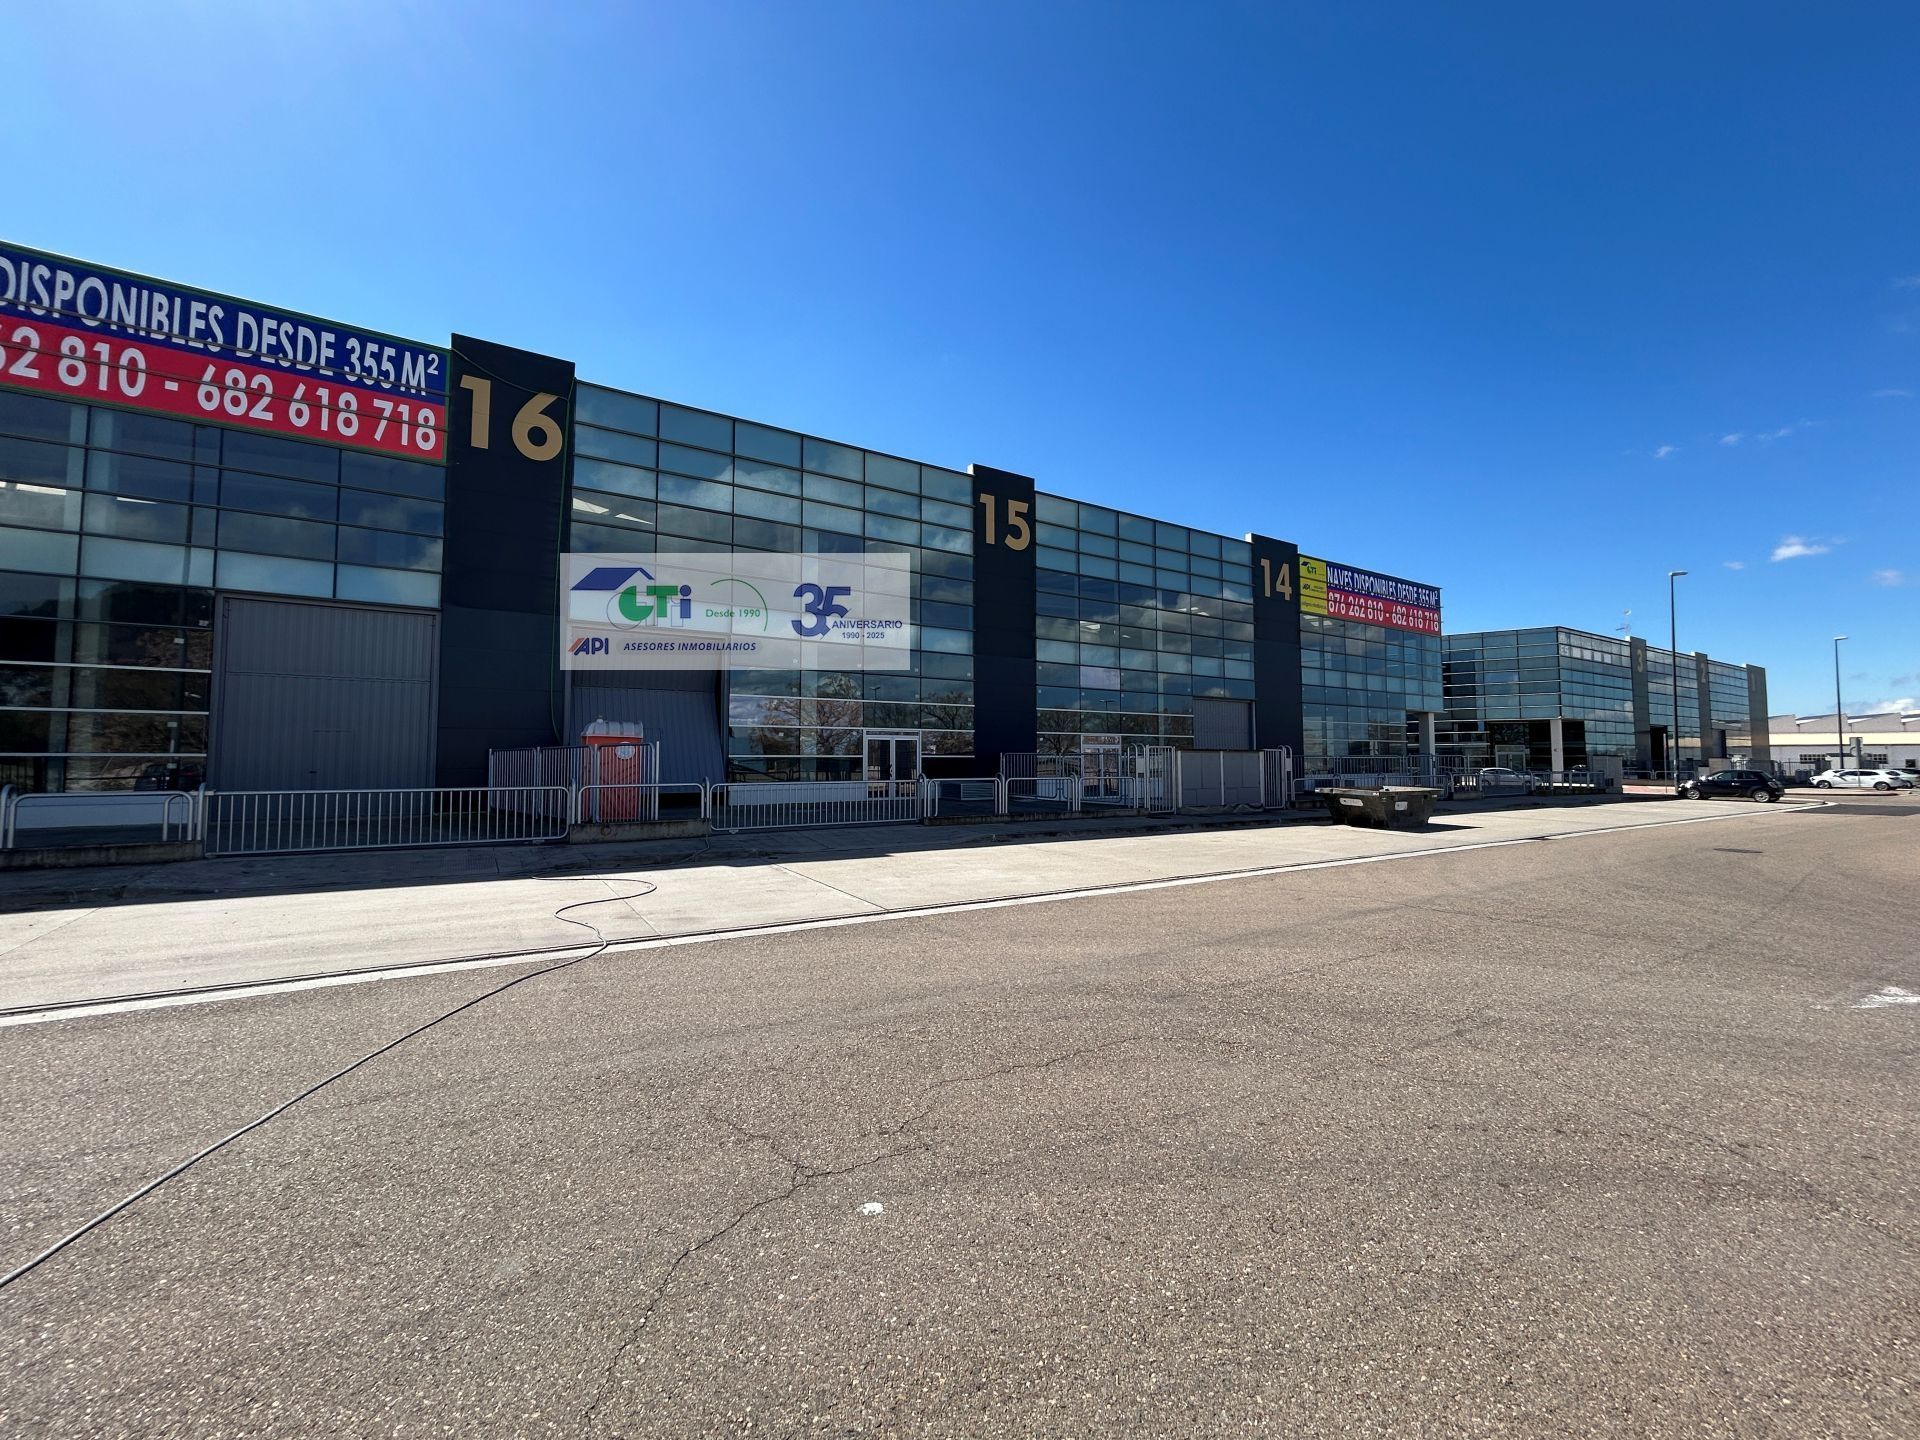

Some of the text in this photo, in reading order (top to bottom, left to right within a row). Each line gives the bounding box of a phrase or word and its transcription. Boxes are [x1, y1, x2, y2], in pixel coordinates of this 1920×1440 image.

[0, 257, 224, 352] DISPONIBLES
[236, 312, 336, 376] DESDE
[344, 338, 395, 388] 355
[0, 325, 40, 379] 2
[58, 336, 146, 398] 810
[197, 364, 274, 421] 682
[289, 382, 359, 436] 618
[373, 399, 436, 450] 718
[460, 374, 563, 461] 16
[979, 493, 1031, 551] 15
[1260, 558, 1293, 601] 14
[1327, 567, 1352, 591] NAVES
[1353, 572, 1396, 601] DISPONIBLES
[1397, 584, 1417, 605] DESDE
[1367, 600, 1384, 621] 810
[1392, 605, 1407, 626] 682
[1408, 609, 1424, 629] 618
[1424, 612, 1439, 632] 718
[1636, 648, 1644, 673] 3
[1700, 662, 1707, 684] 2
